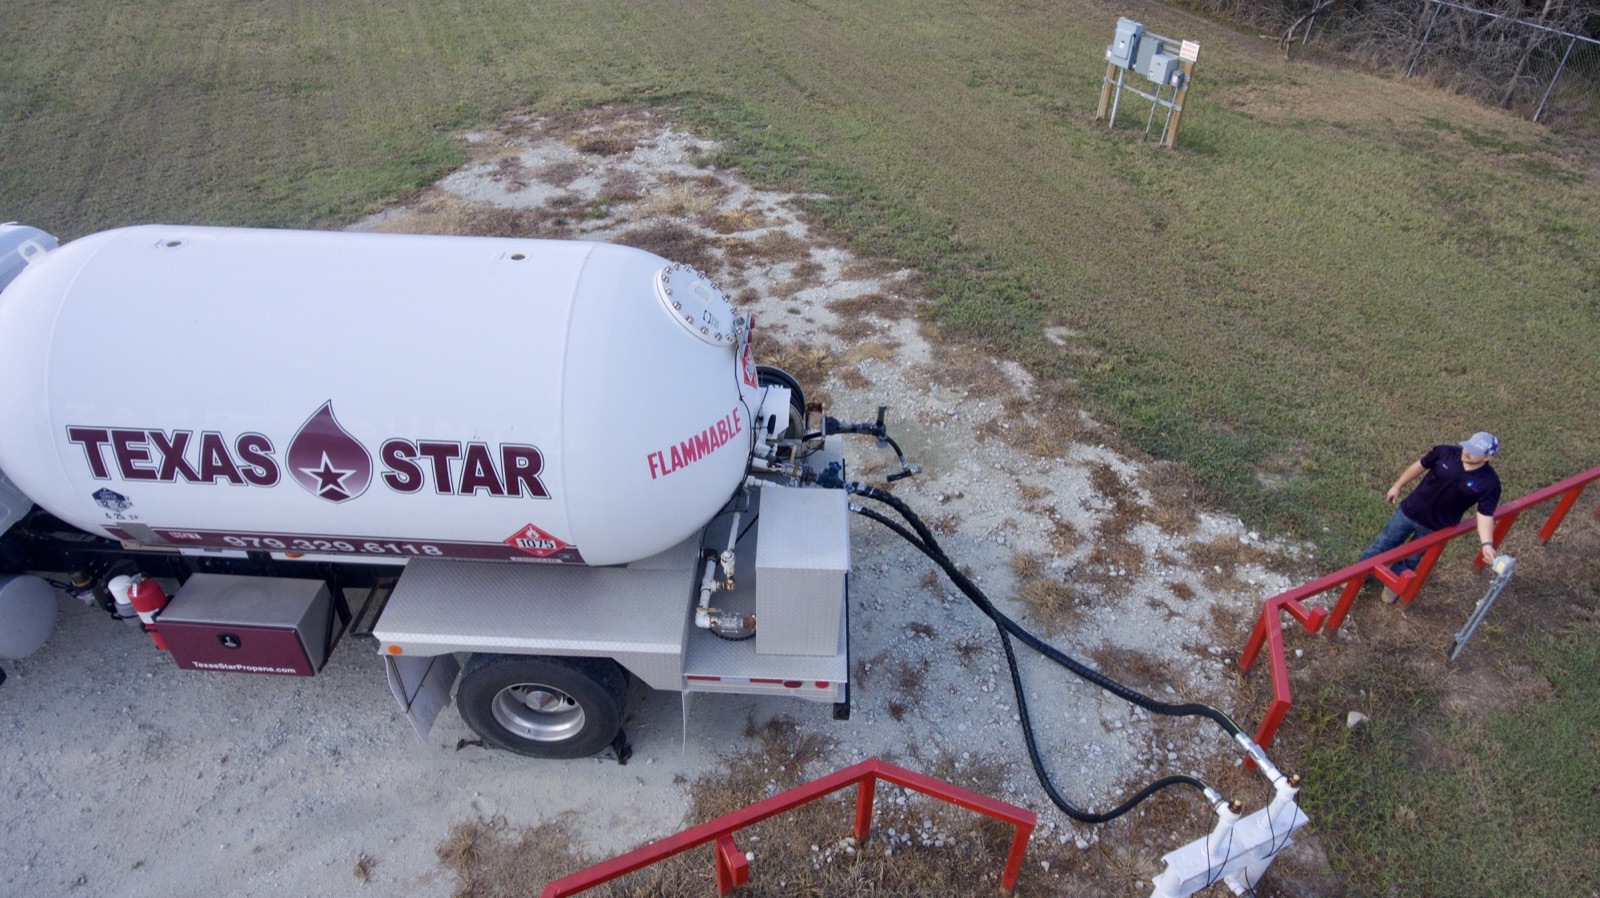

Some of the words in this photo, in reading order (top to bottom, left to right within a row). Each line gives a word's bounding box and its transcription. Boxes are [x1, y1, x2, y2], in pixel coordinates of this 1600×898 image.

[647, 407, 741, 480] FLAMMABLE
[66, 425, 281, 487] TEXAS
[379, 438, 552, 499] STAR
[223, 536, 444, 556] 979.329.6118
[520, 539, 554, 549] 1075
[192, 661, 296, 674] TexasStarPropane.com
